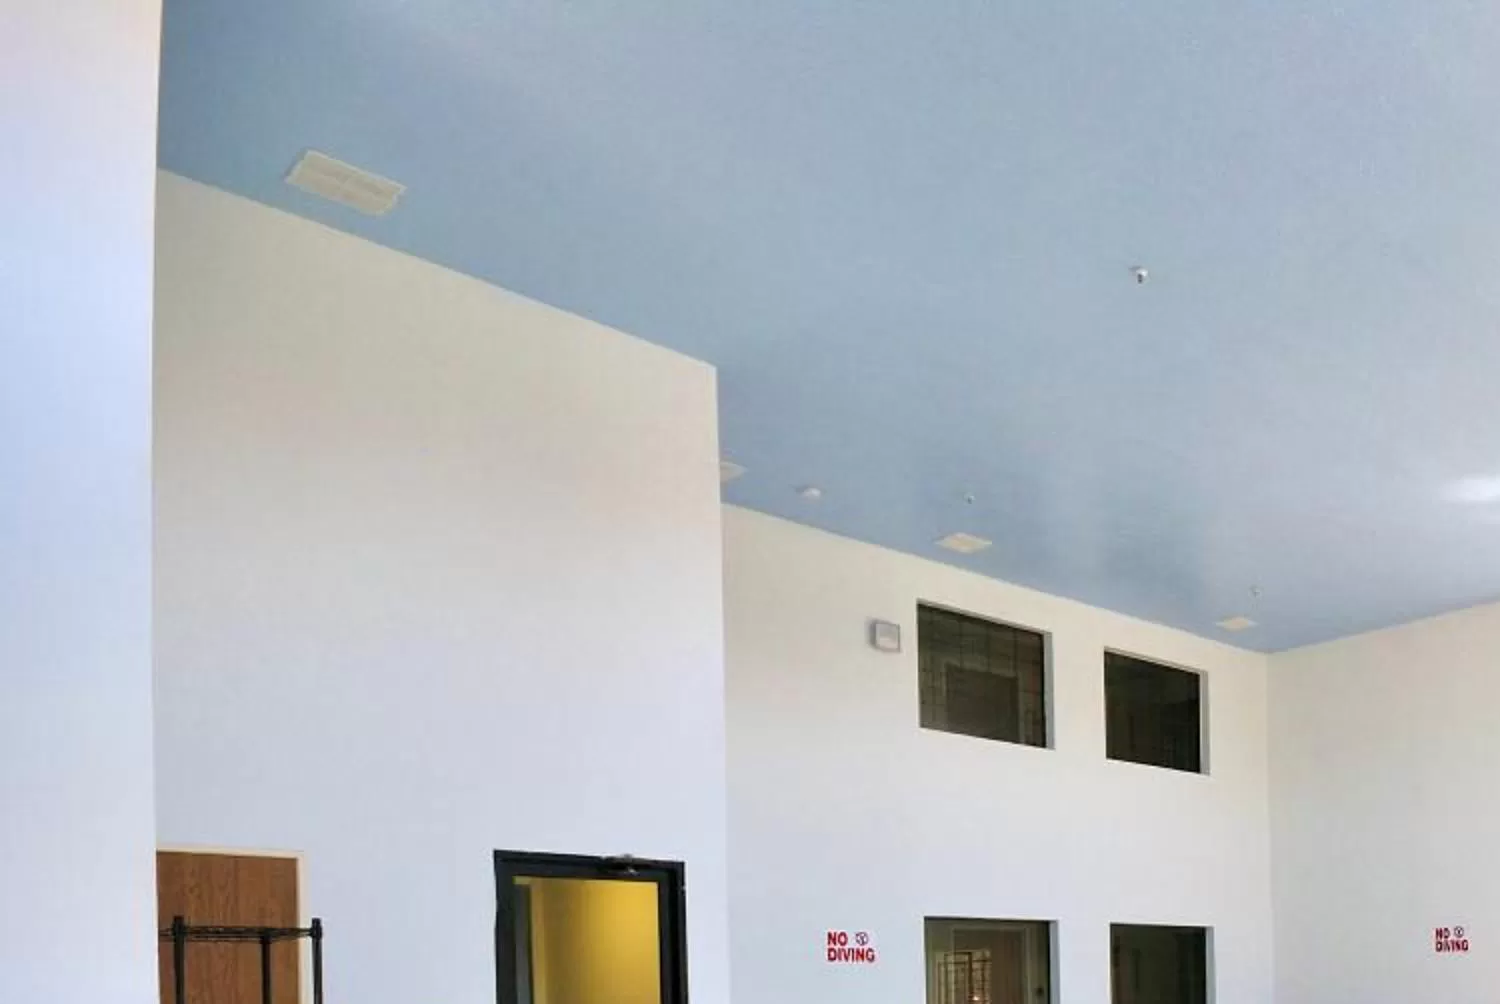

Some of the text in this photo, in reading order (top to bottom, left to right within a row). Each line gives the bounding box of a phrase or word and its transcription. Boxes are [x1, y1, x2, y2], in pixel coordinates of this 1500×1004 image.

[827, 931, 848, 946] NO
[1435, 927, 1451, 940] NO
[827, 947, 875, 963] DIVING
